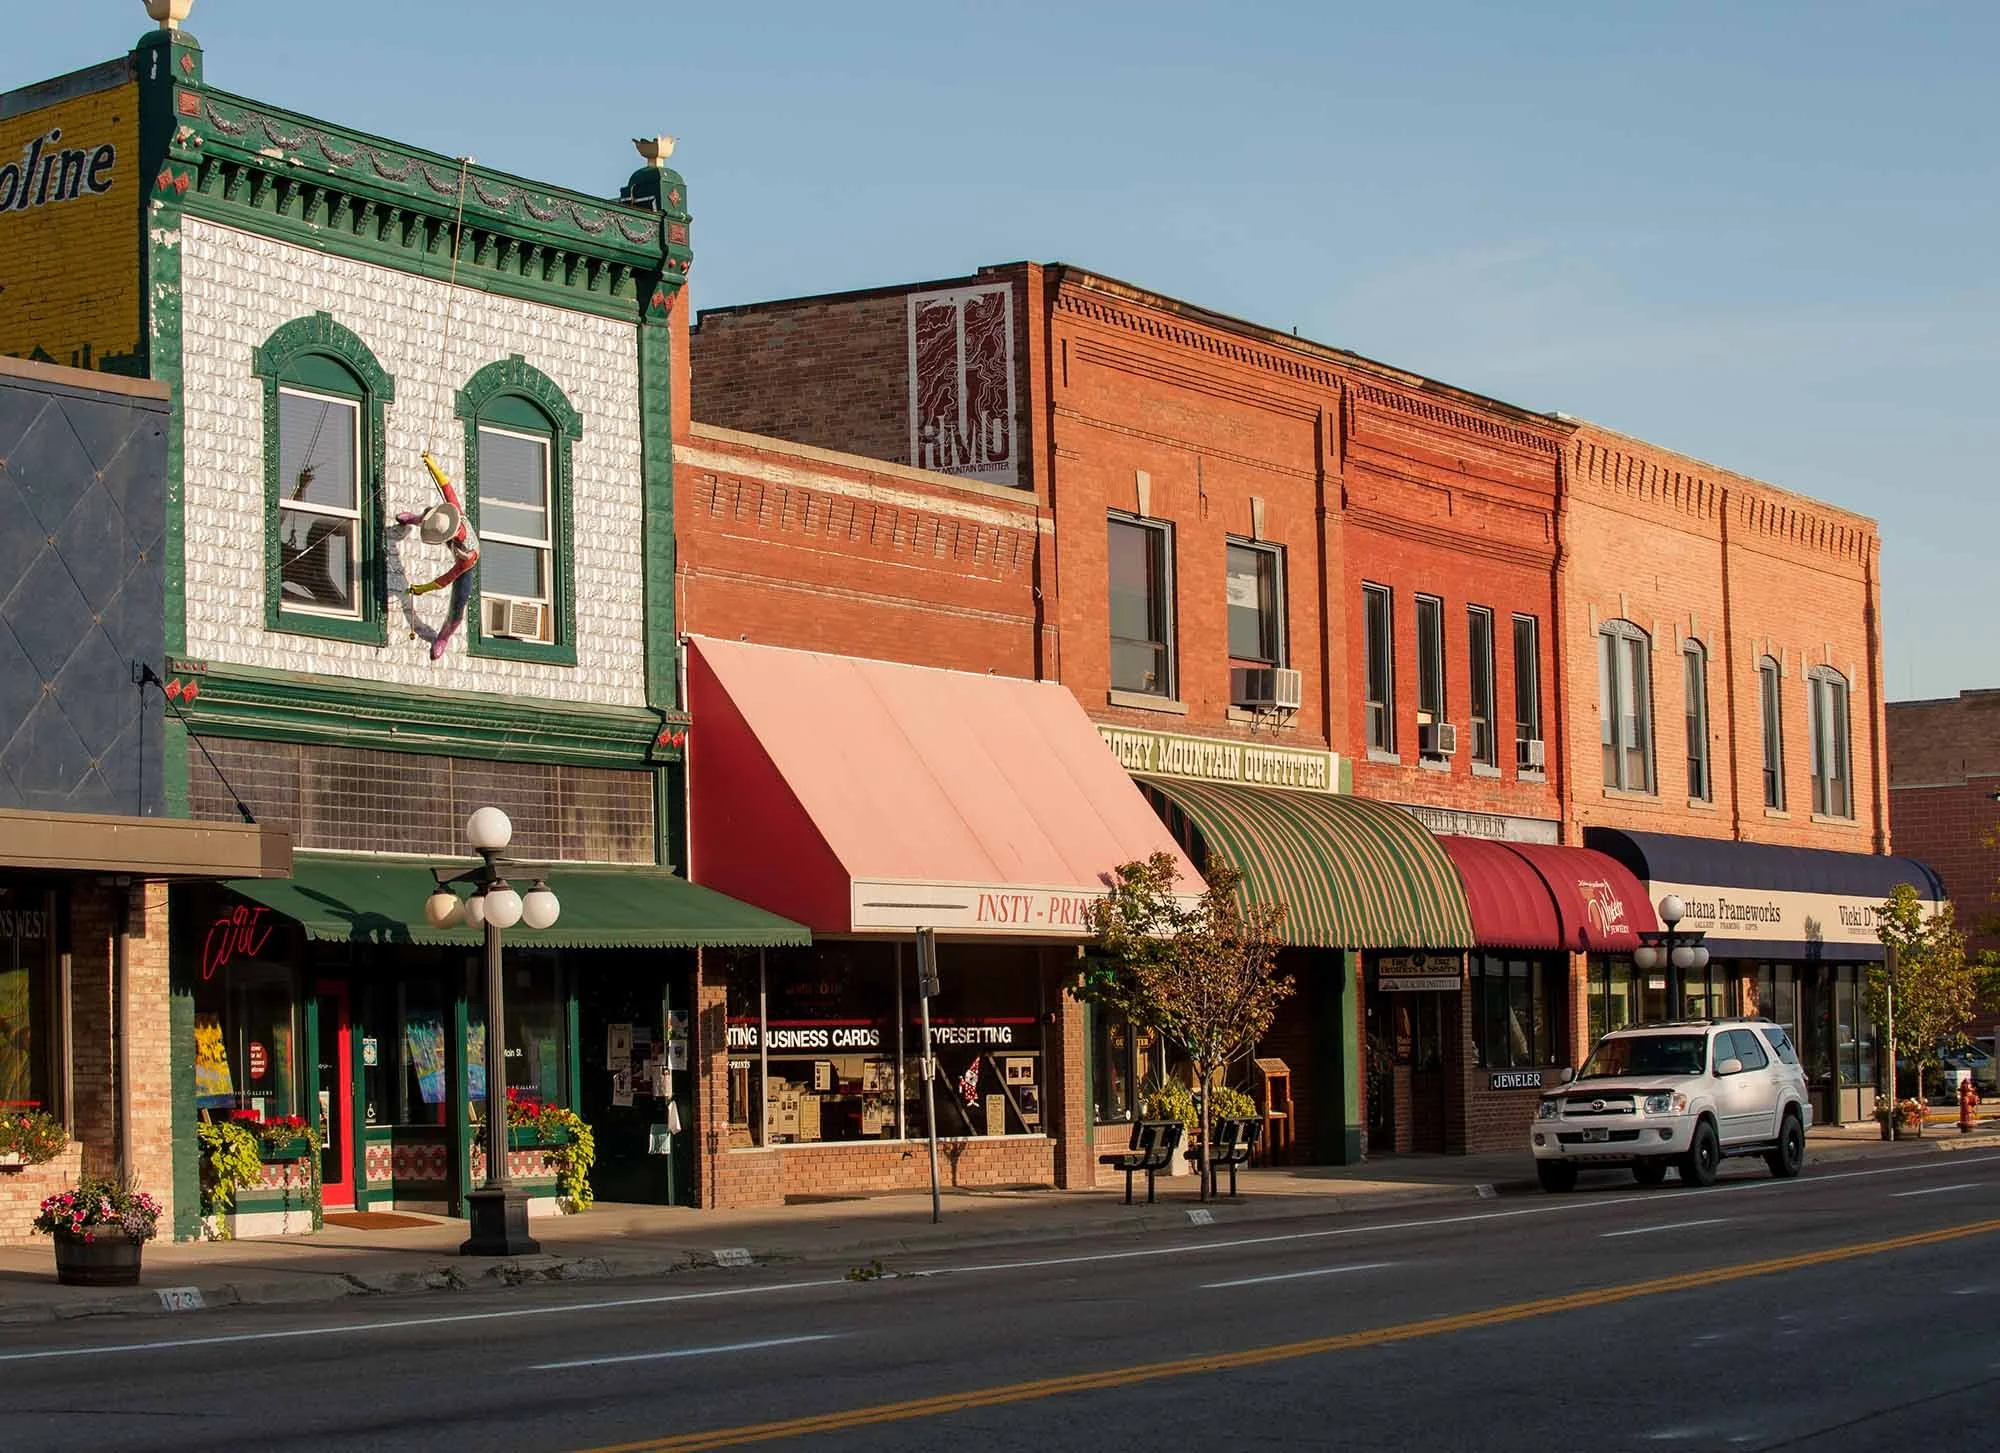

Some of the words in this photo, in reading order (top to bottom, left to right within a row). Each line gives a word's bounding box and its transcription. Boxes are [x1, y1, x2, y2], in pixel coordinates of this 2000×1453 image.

[1158, 738, 1240, 780] MOUNTAIN
[1244, 749, 1326, 790] OUTFITTER
[976, 894, 1034, 923] INSTY
[1682, 899, 1716, 919] ntana
[1718, 898, 1781, 922] Frameworks
[1838, 906, 1862, 927] Vicki
[15, 910, 48, 939] WEST
[832, 1029, 880, 1046] CARDS
[1494, 1073, 1541, 1088] JEWELER
